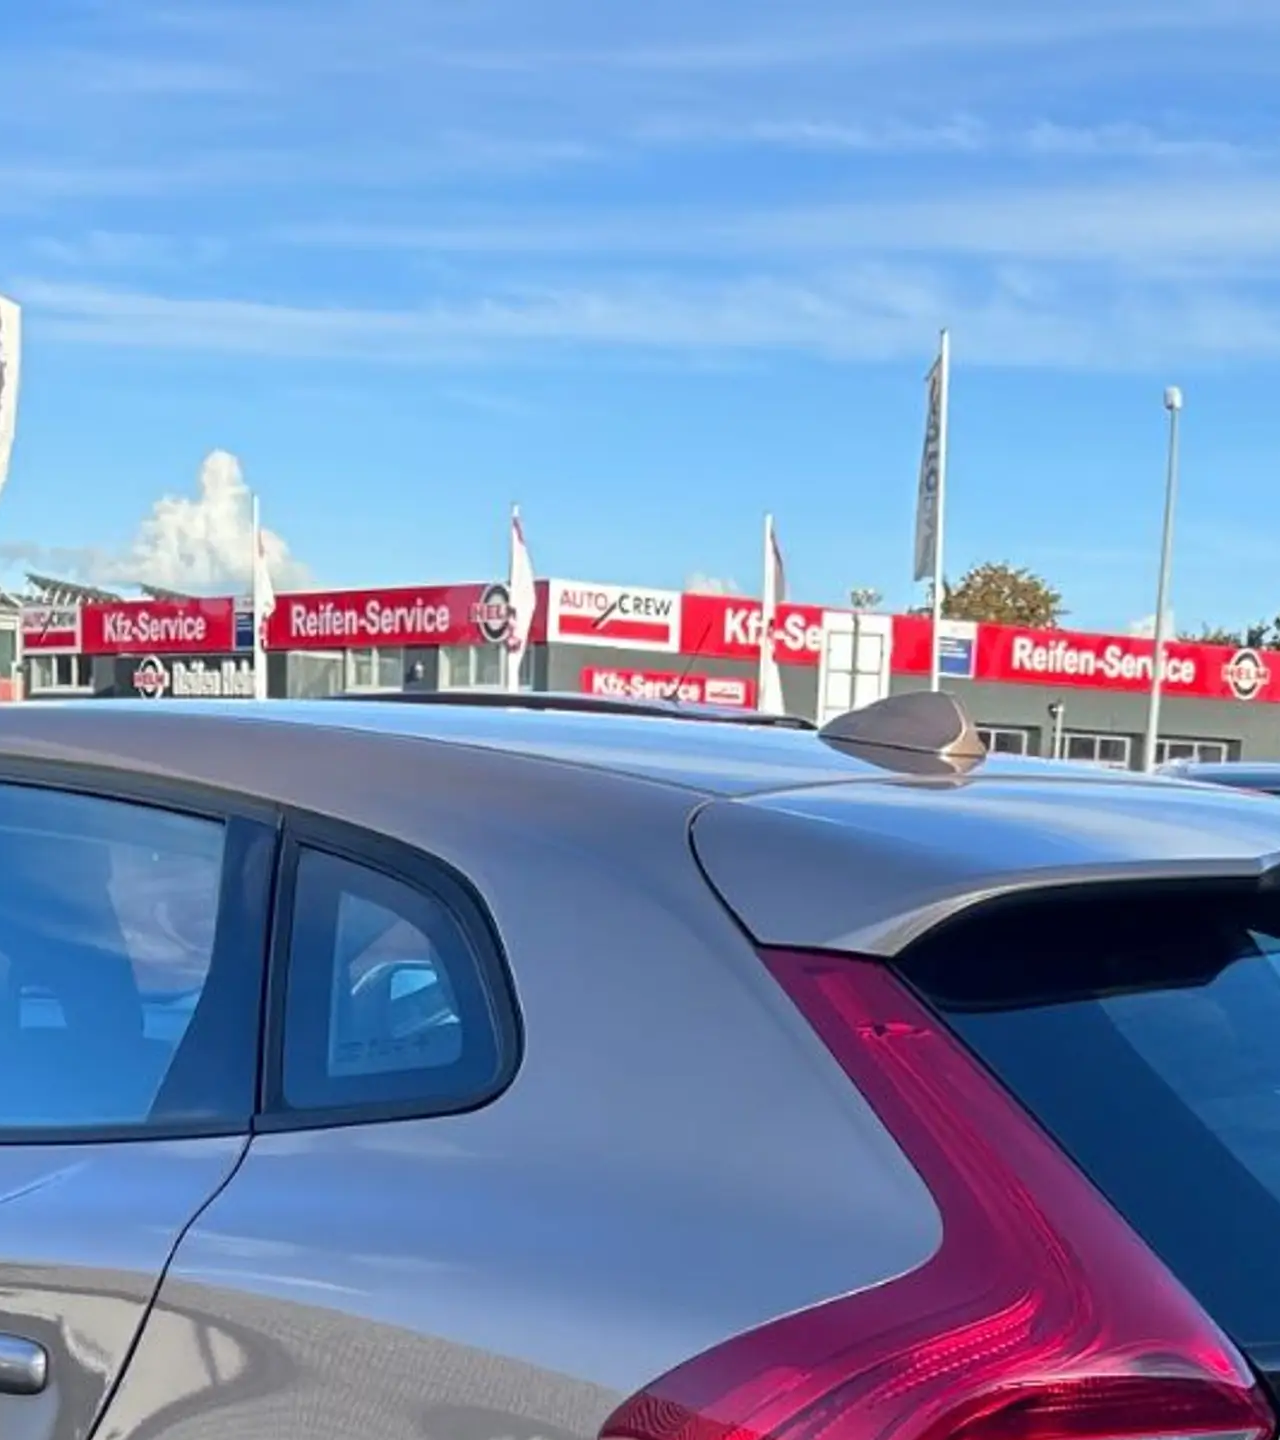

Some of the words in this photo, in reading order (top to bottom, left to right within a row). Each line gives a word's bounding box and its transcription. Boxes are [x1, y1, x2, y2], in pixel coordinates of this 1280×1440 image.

[558, 588, 609, 612] AUTO
[103, 611, 207, 643] Kfz-Service
[290, 598, 450, 638] Reifen-Service
